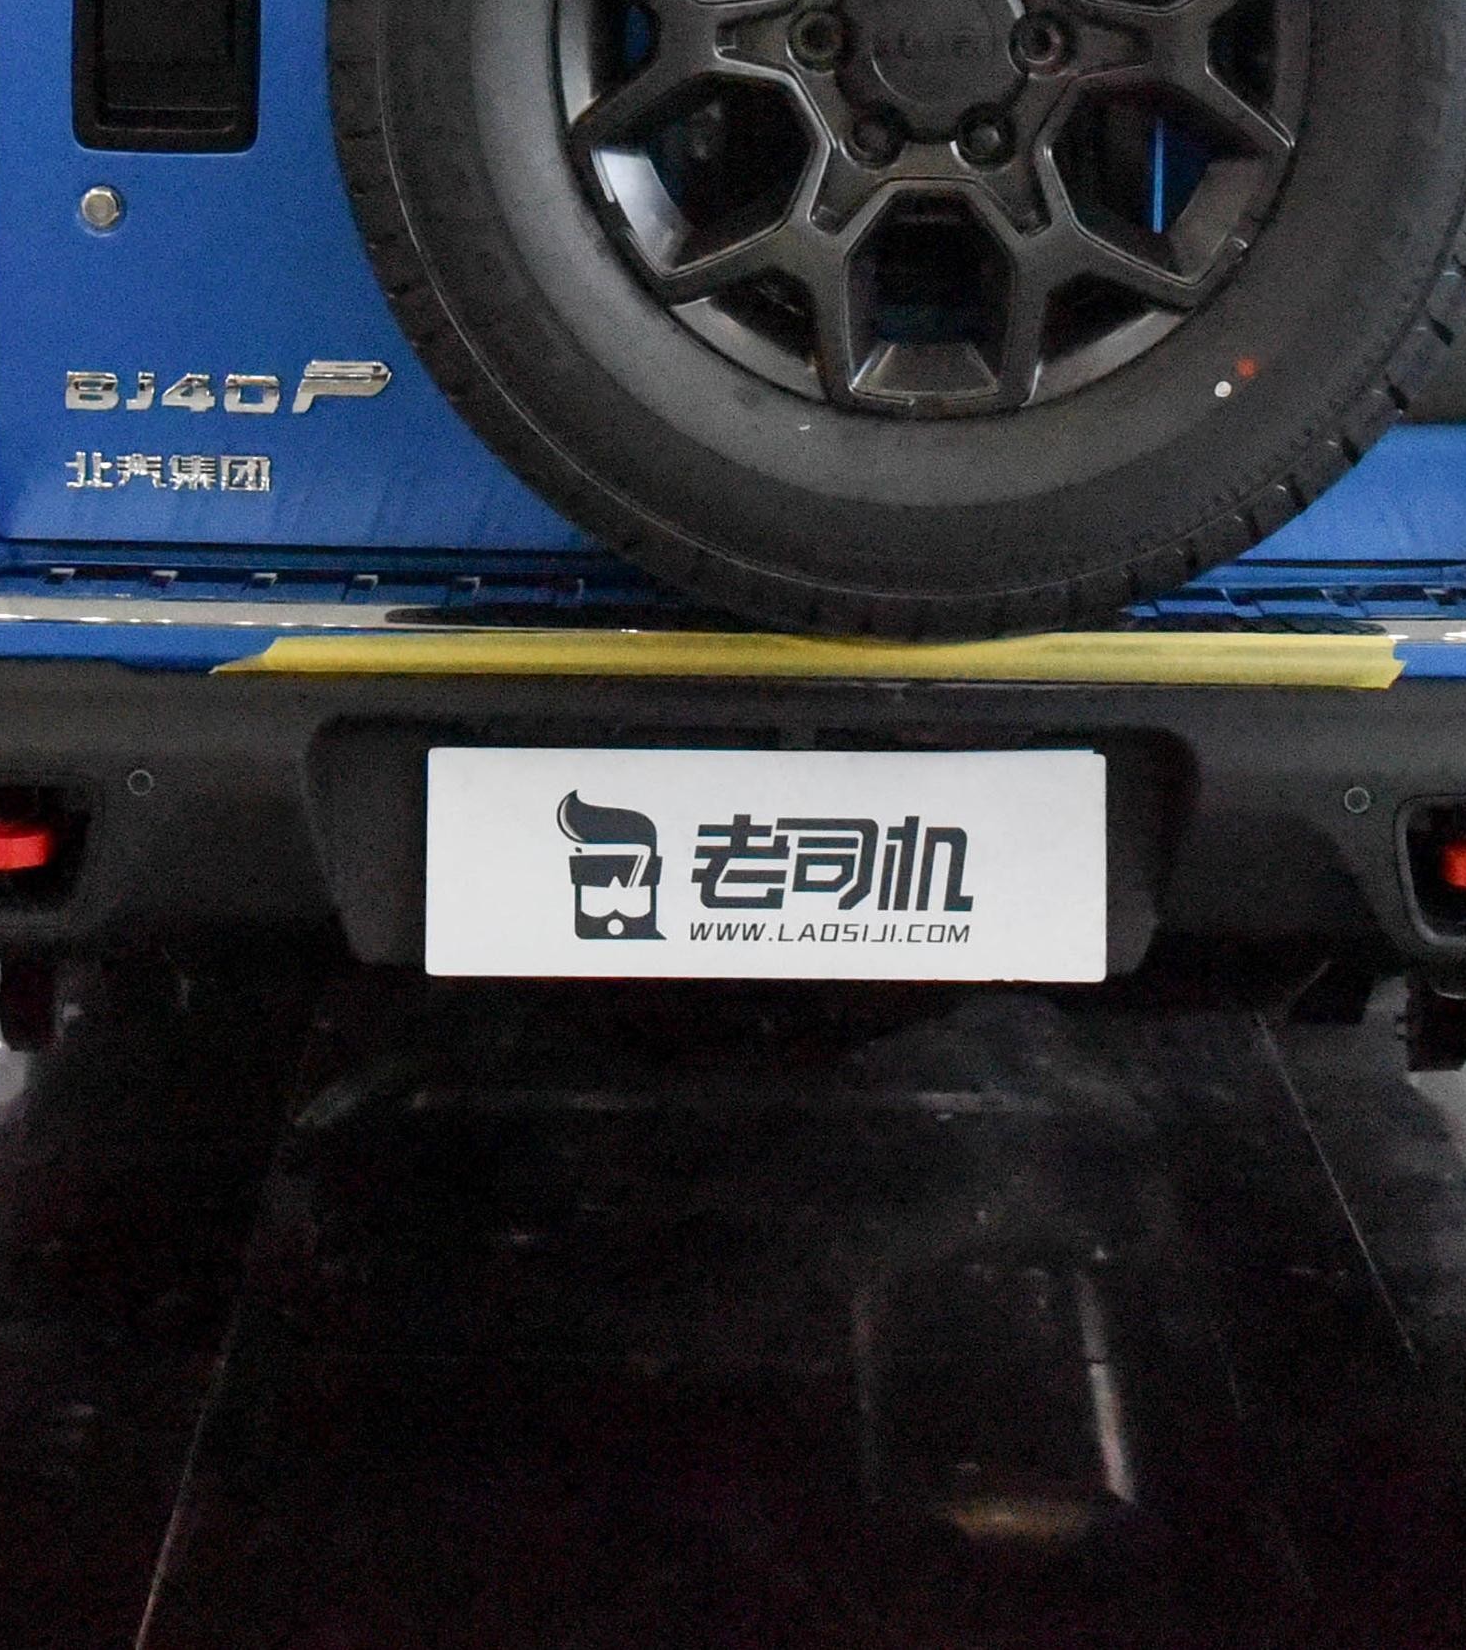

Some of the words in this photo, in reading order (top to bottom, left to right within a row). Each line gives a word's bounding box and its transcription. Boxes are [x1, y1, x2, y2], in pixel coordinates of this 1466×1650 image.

[64, 451, 271, 492] 北汽集团
[690, 813, 974, 913] 老司机
[689, 922, 971, 944] WWW.LAOSIJI.COM
